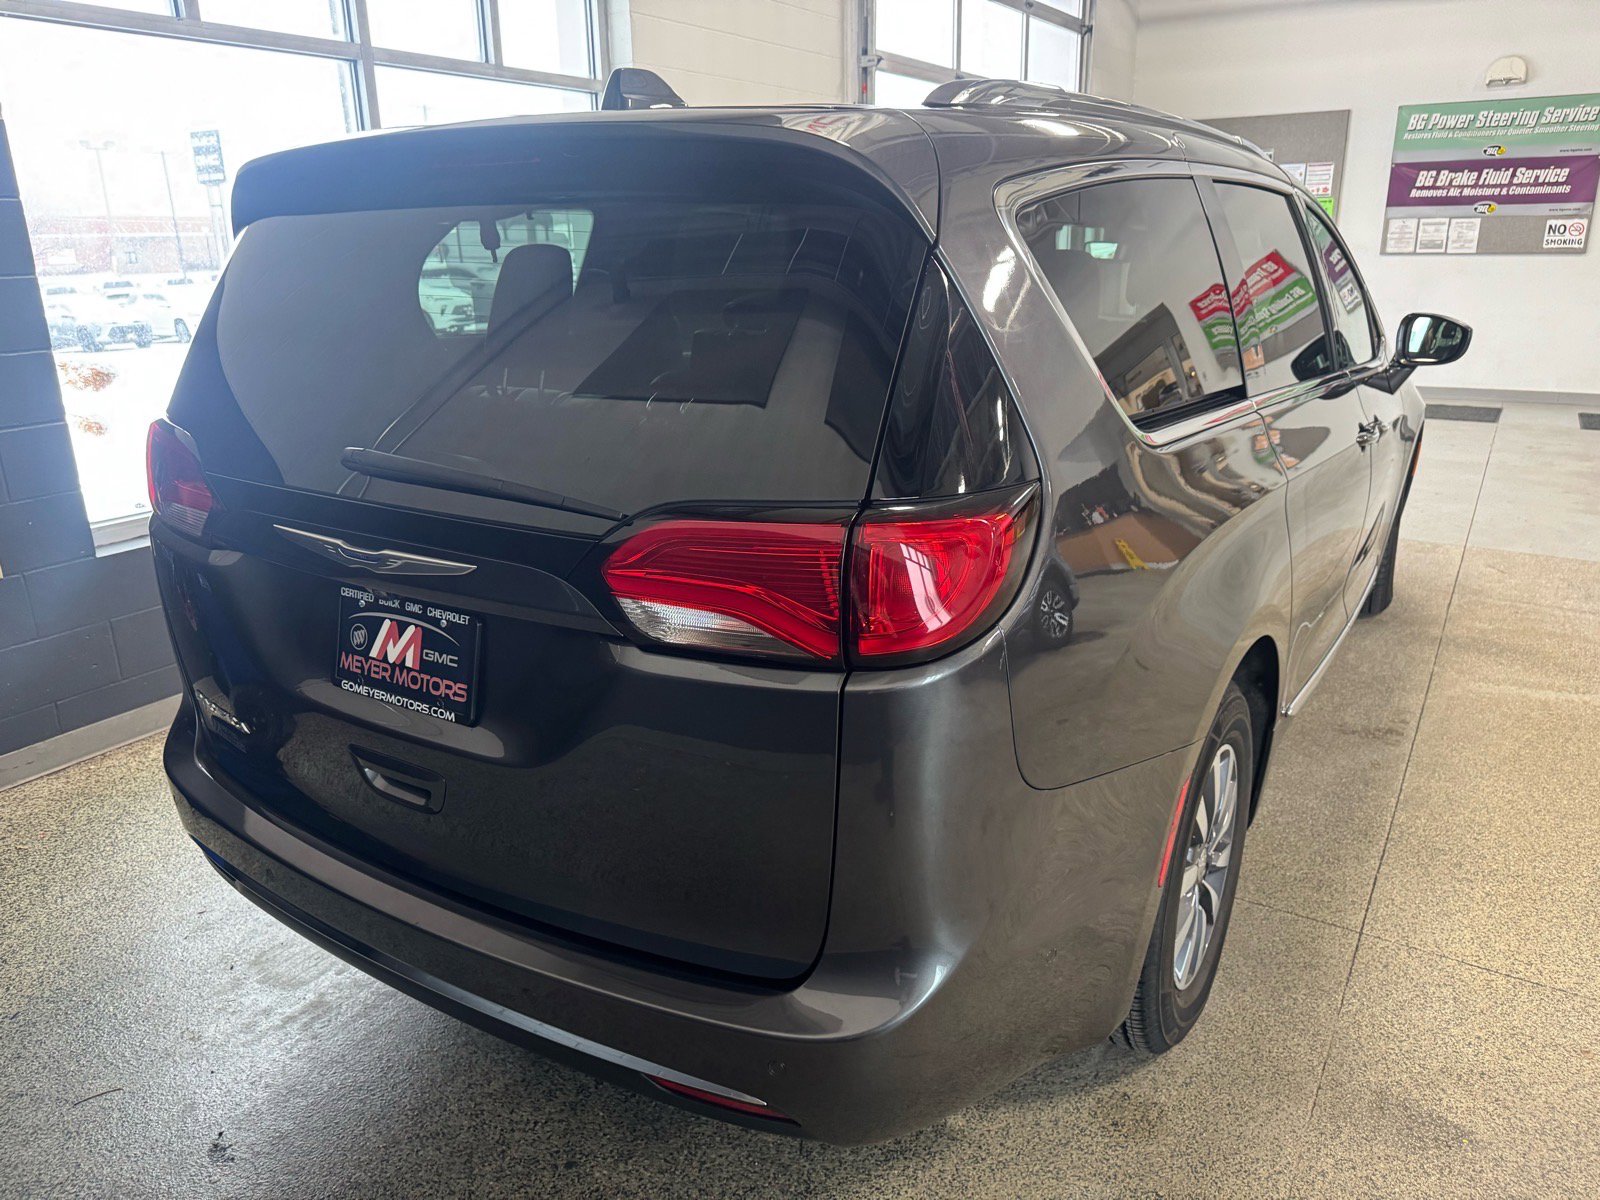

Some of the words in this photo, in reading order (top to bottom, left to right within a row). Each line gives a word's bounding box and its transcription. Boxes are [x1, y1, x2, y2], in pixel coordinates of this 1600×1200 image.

[1407, 114, 1428, 131] BG
[1427, 112, 1475, 130] Power
[1476, 109, 1540, 128] Steering
[1541, 104, 1600, 124] Service
[1431, 130, 1449, 139] Fluid
[1533, 125, 1570, 134] Smoother
[1568, 123, 1600, 132] Steering
[1415, 170, 1437, 187] BG
[1436, 169, 1478, 187] Brake
[1479, 167, 1513, 185] Fluid
[1512, 165, 1570, 184] Service
[1409, 188, 1448, 198] Removes
[1447, 187, 1461, 198] Air,
[1461, 186, 1501, 196] Moisture
[1500, 187, 1508, 195] &
[1508, 184, 1572, 195] Contaminants
[1547, 223, 1567, 235] NO
[1544, 238, 1583, 246] SMOKING
[340, 586, 375, 603] CERTIFIED
[405, 601, 423, 614] GMC
[427, 607, 471, 625] CHEVROLET
[422, 649, 459, 668] GMC
[339, 651, 391, 683] MEYER
[393, 666, 468, 703] MOTORS
[341, 680, 456, 722] GOMEYERMOTORS.COM
